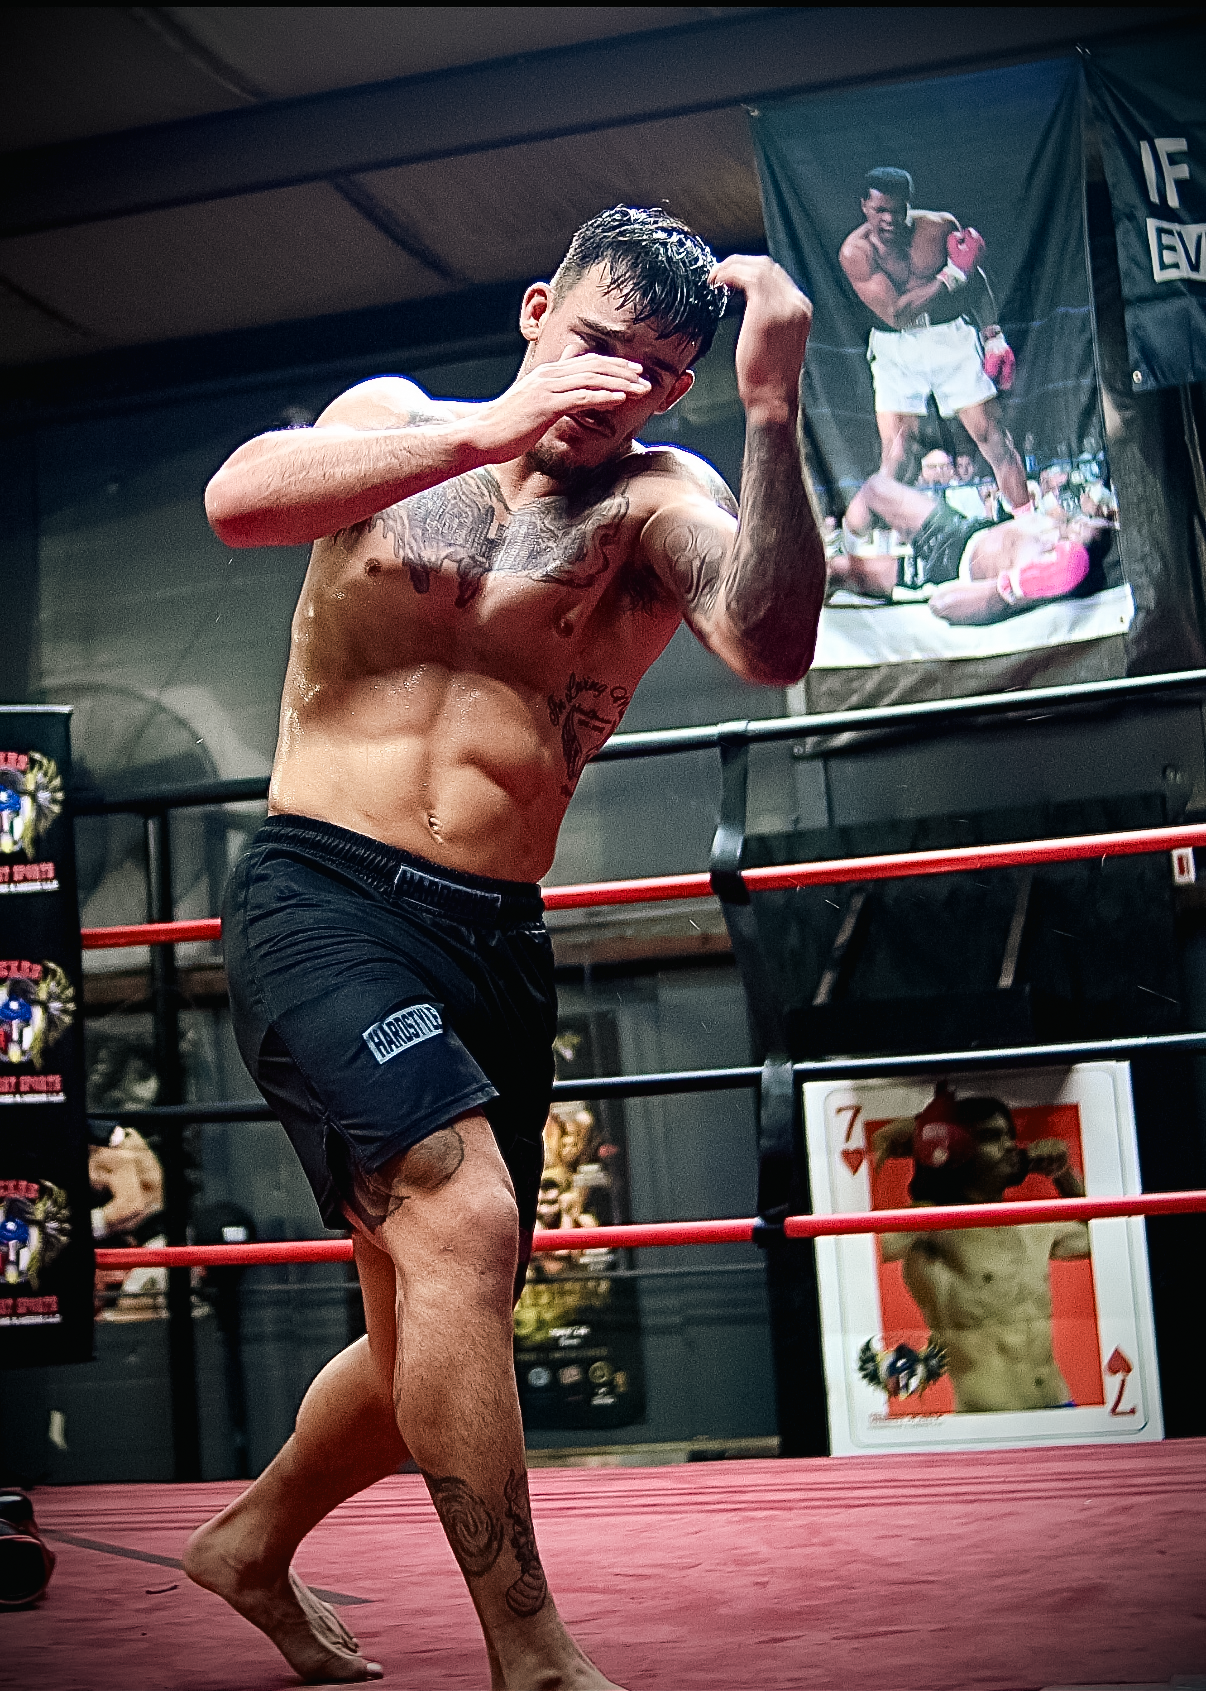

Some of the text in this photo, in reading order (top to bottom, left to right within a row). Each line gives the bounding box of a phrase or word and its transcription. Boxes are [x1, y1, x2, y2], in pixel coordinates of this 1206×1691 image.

[1140, 137, 1190, 208] IF
[367, 1005, 443, 1059] HARDSTYLE
[835, 1104, 863, 1143] 7
[1108, 1377, 1137, 1416] 7
